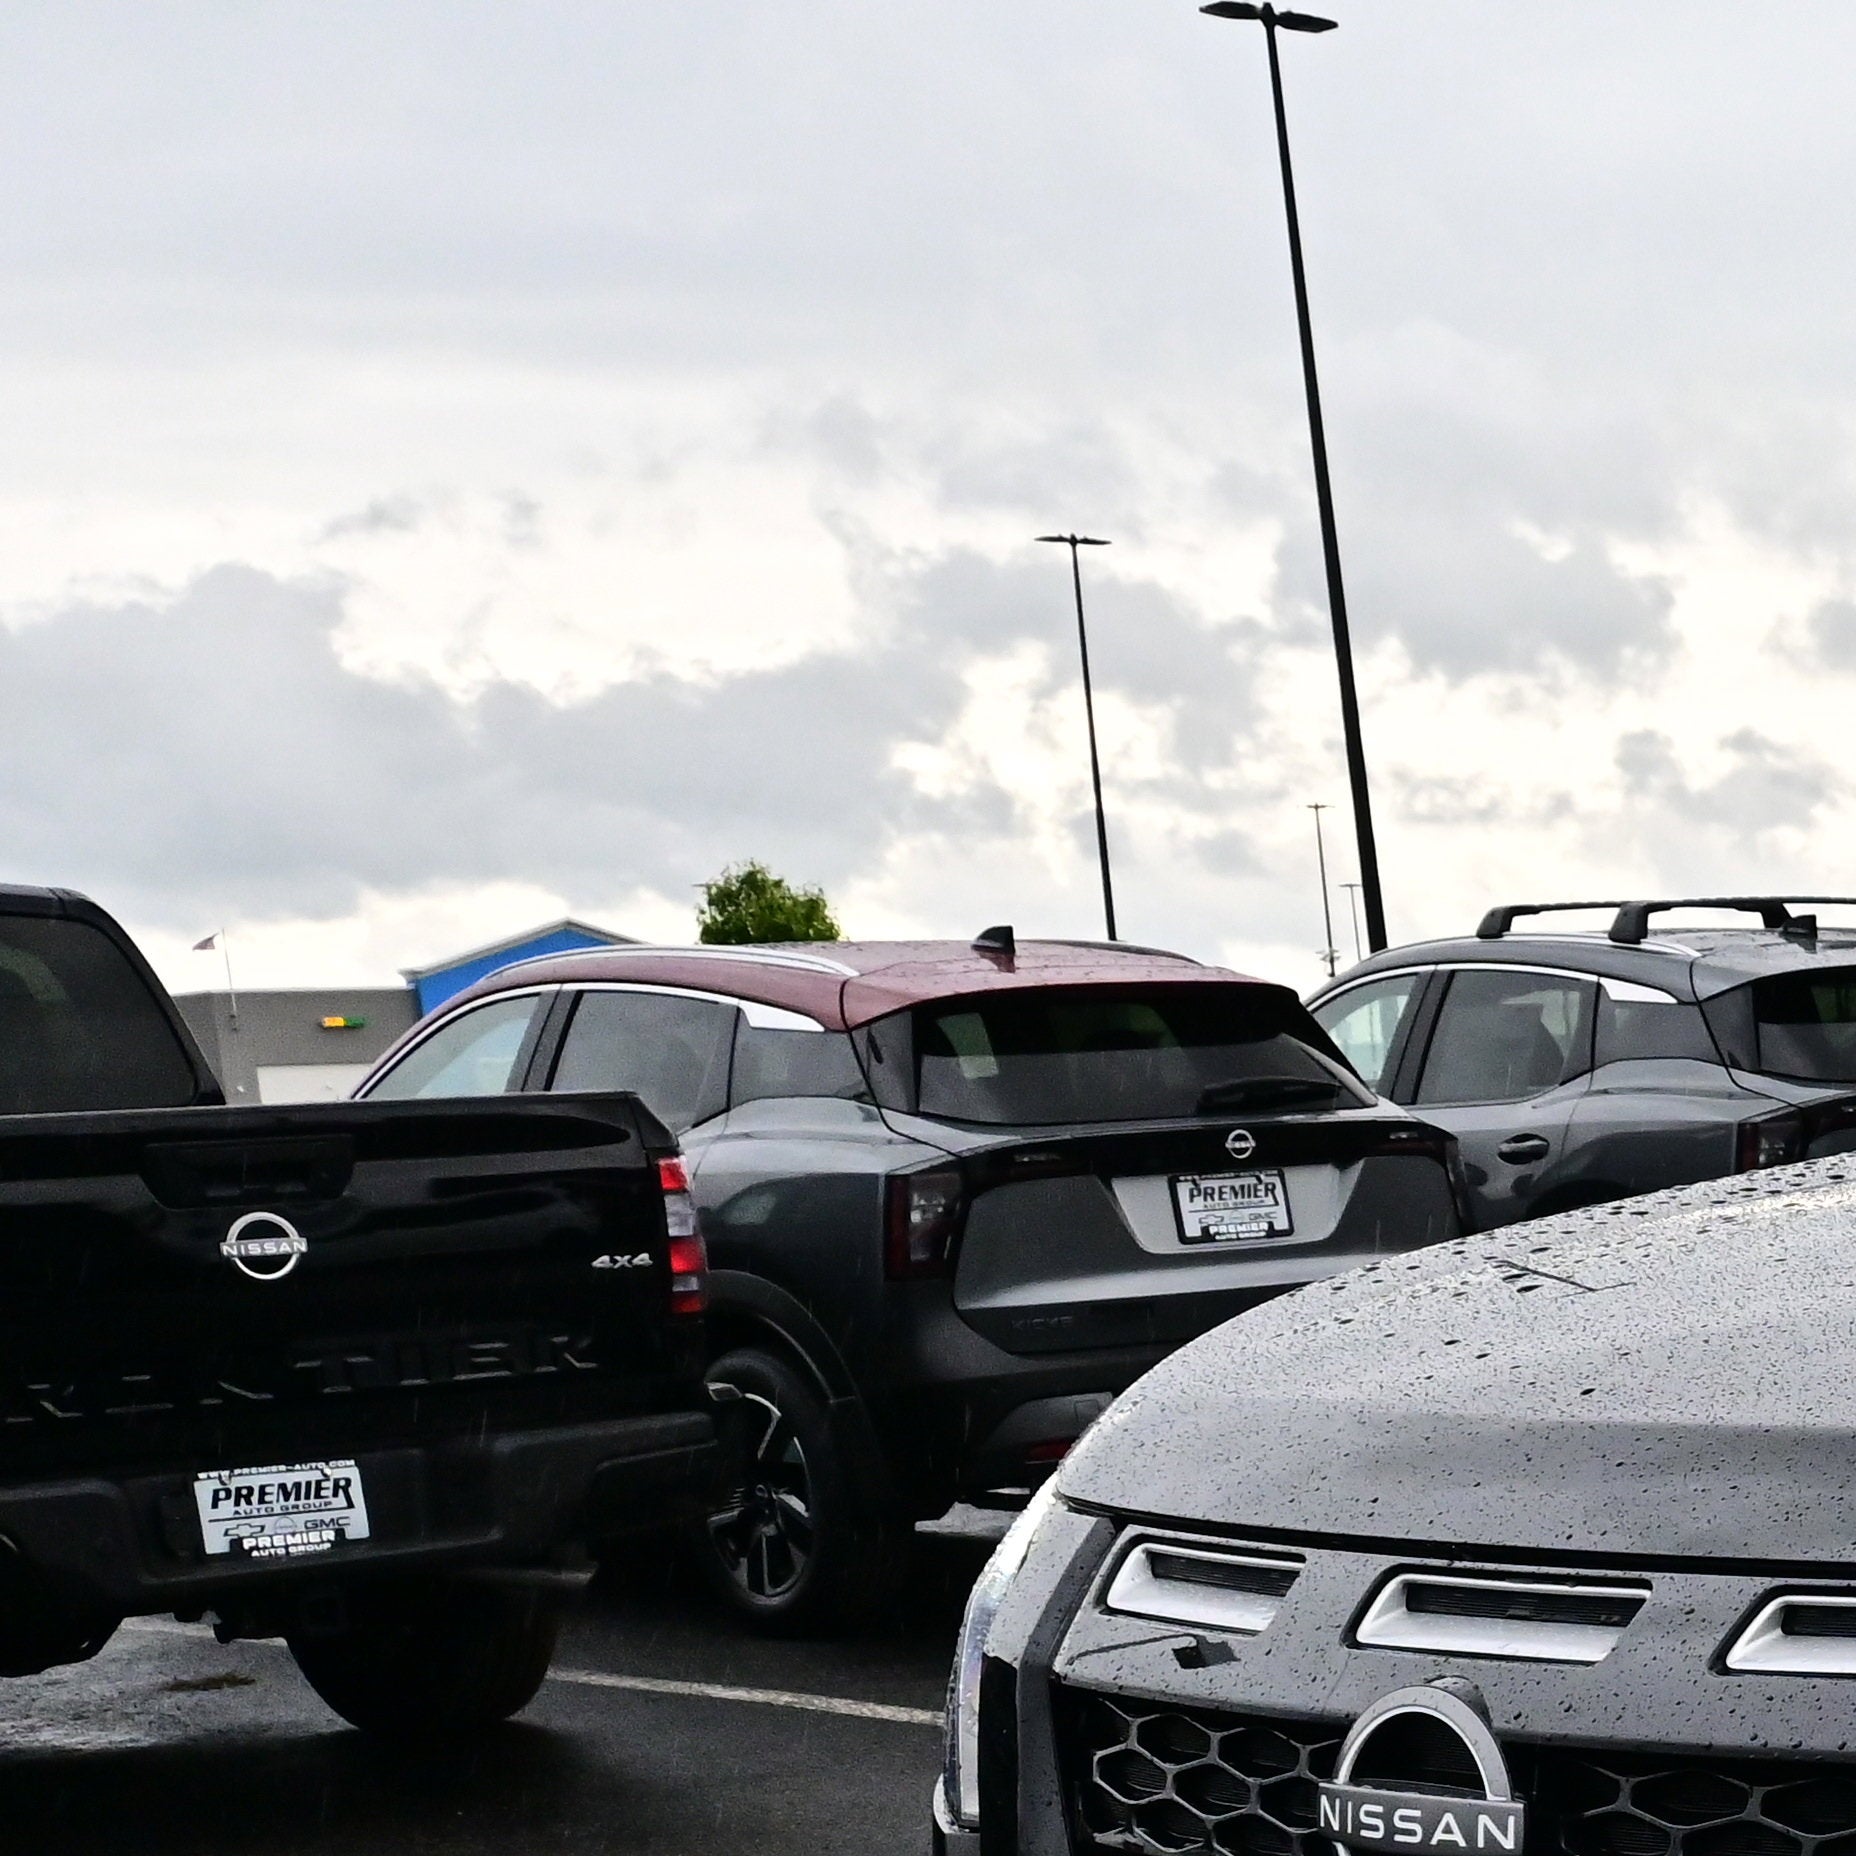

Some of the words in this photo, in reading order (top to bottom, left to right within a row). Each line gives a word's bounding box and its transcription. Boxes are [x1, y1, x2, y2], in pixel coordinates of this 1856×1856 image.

[1188, 1182, 1279, 1206] PREMIER
[1208, 1221, 1269, 1235] PREMIER
[222, 1241, 308, 1256] NISSAN
[211, 1477, 355, 1509] PREMIER
[233, 1506, 275, 1516] AUTO
[280, 1501, 333, 1512] GROUP
[304, 1517, 350, 1530] GMC
[242, 1530, 336, 1550] PREMIER
[251, 1547, 287, 1558] AUTO
[288, 1542, 332, 1556] GROUP
[1319, 1794, 1516, 1850] NISSAN
